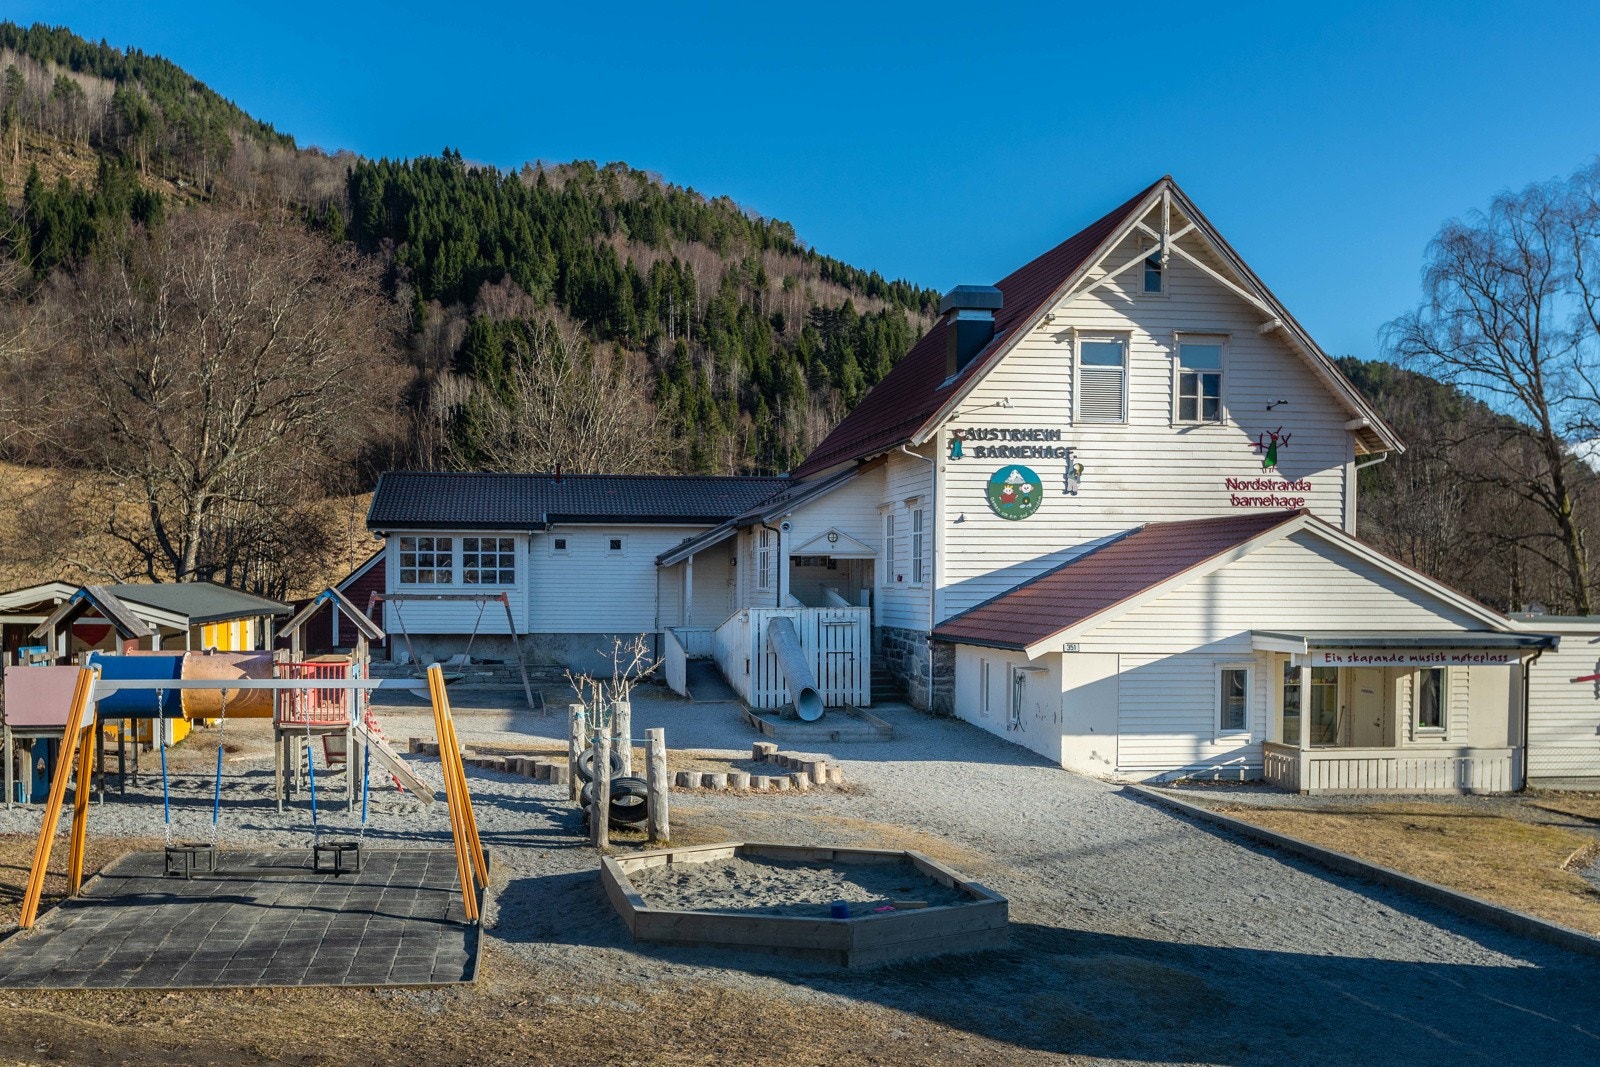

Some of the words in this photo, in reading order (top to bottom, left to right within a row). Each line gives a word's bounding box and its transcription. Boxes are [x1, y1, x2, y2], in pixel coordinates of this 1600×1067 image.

[966, 427, 1061, 441] AUSTRHEIM
[973, 445, 1077, 459] BARNEHAGE
[1225, 477, 1312, 491] Nordstranda
[1230, 493, 1306, 510] barnehage
[1325, 652, 1343, 663] Ein
[1347, 652, 1405, 664] skapande
[1409, 652, 1447, 662] musisk
[1451, 652, 1509, 663] møteplass
